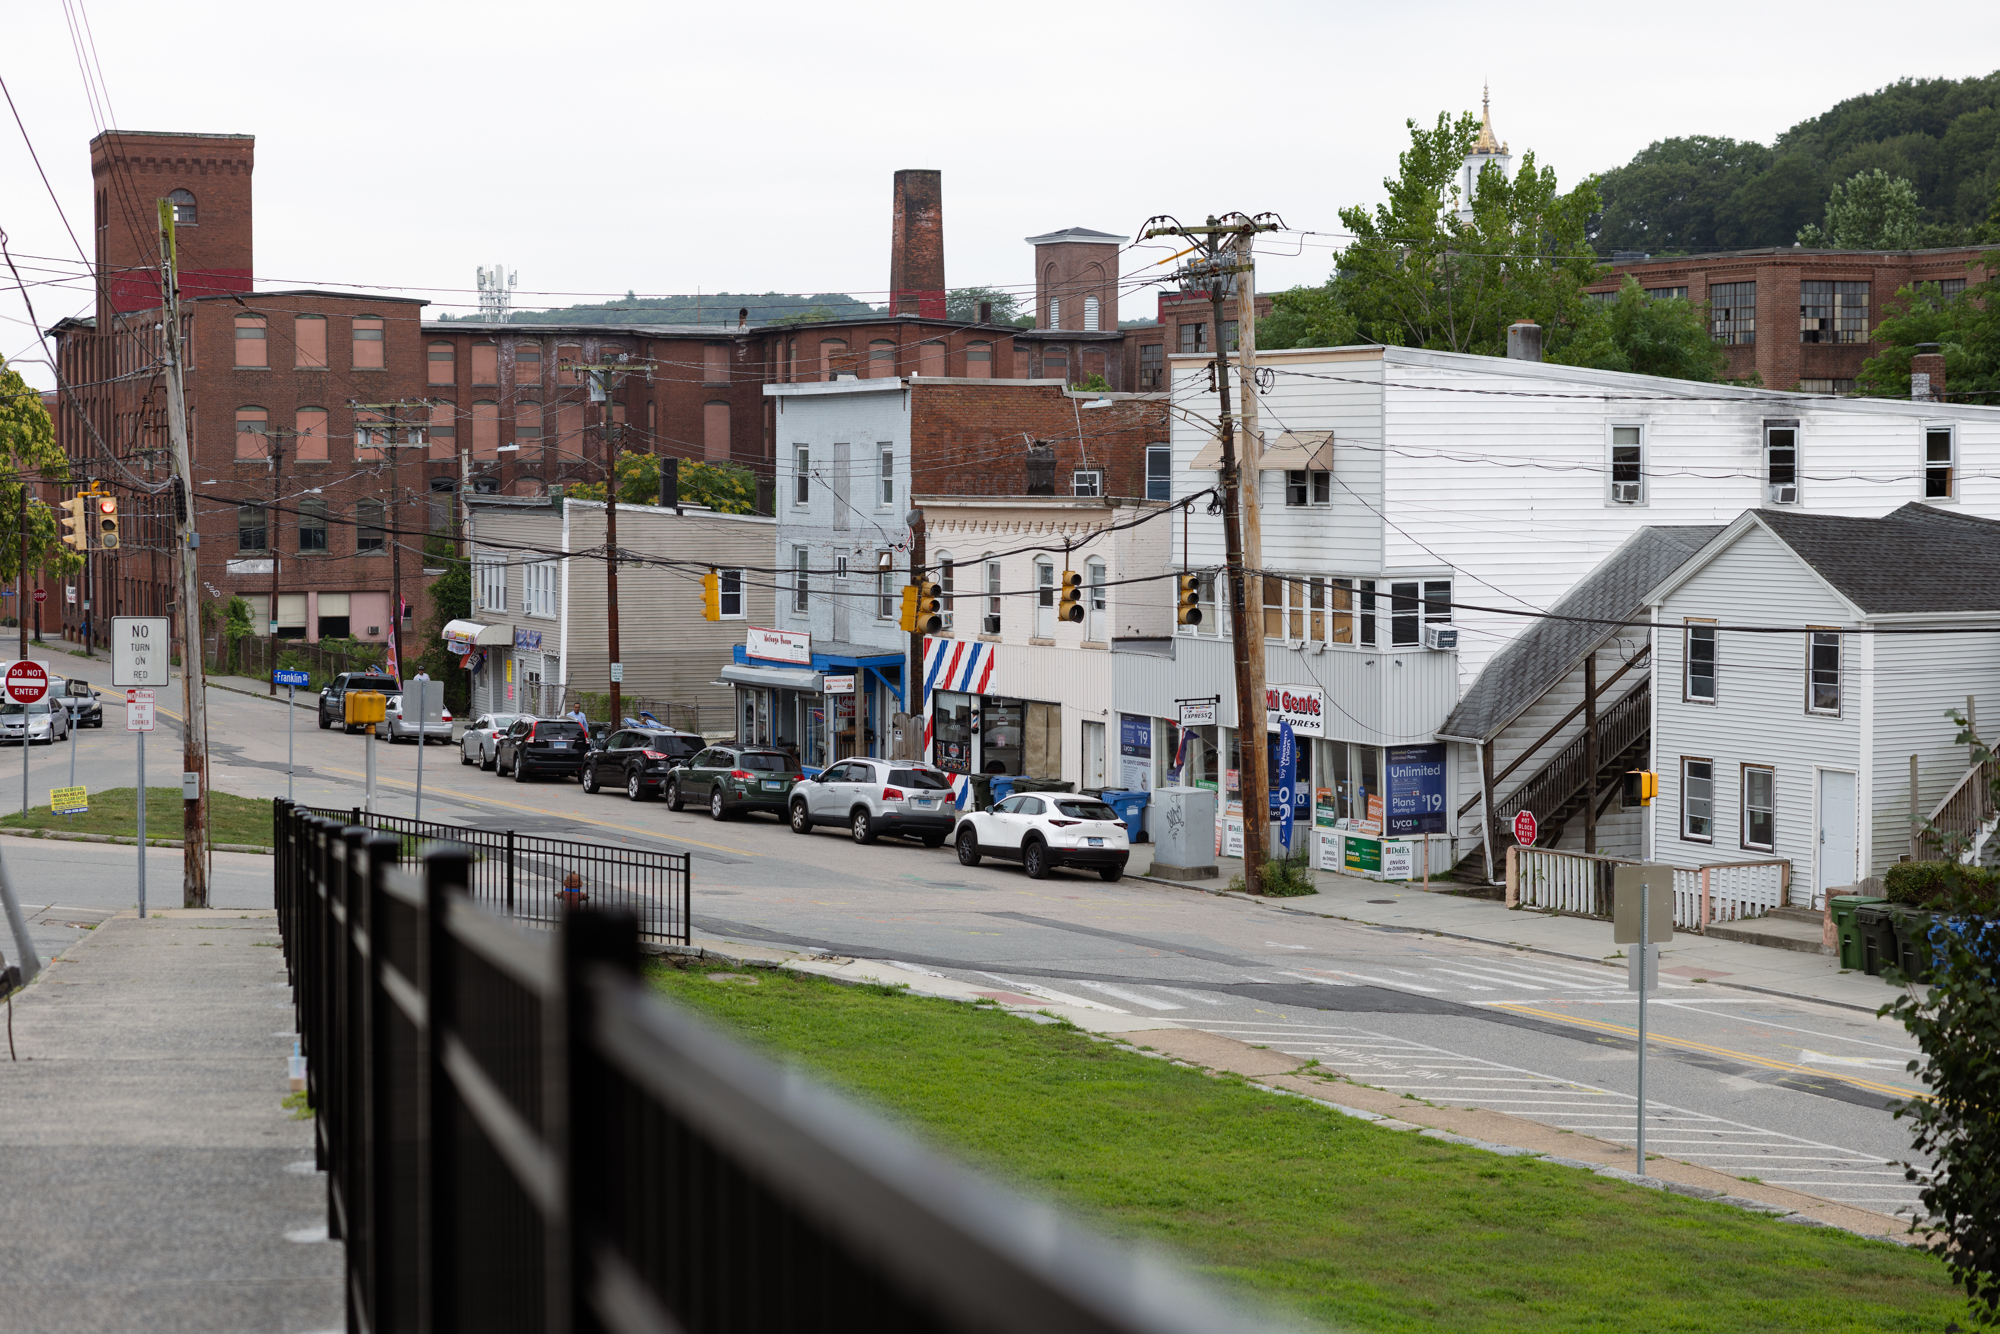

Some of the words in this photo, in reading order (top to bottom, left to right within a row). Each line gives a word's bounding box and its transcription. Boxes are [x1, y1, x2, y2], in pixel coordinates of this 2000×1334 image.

[132, 625, 148, 638] NO
[130, 643, 150, 652] TURN
[277, 672, 302, 683] Franklin
[14, 688, 38, 696] ENTER
[128, 692, 135, 700] NO
[1266, 689, 1279, 711] Mi
[1282, 690, 1320, 716] Gente
[1138, 731, 1148, 744] $19
[1280, 769, 1286, 778] by
[1392, 764, 1440, 778] Unlimited
[1393, 798, 1415, 807] Plans
[1422, 794, 1442, 811] $19
[1393, 819, 1412, 829] Lyca
[1326, 837, 1337, 845] DolEx
